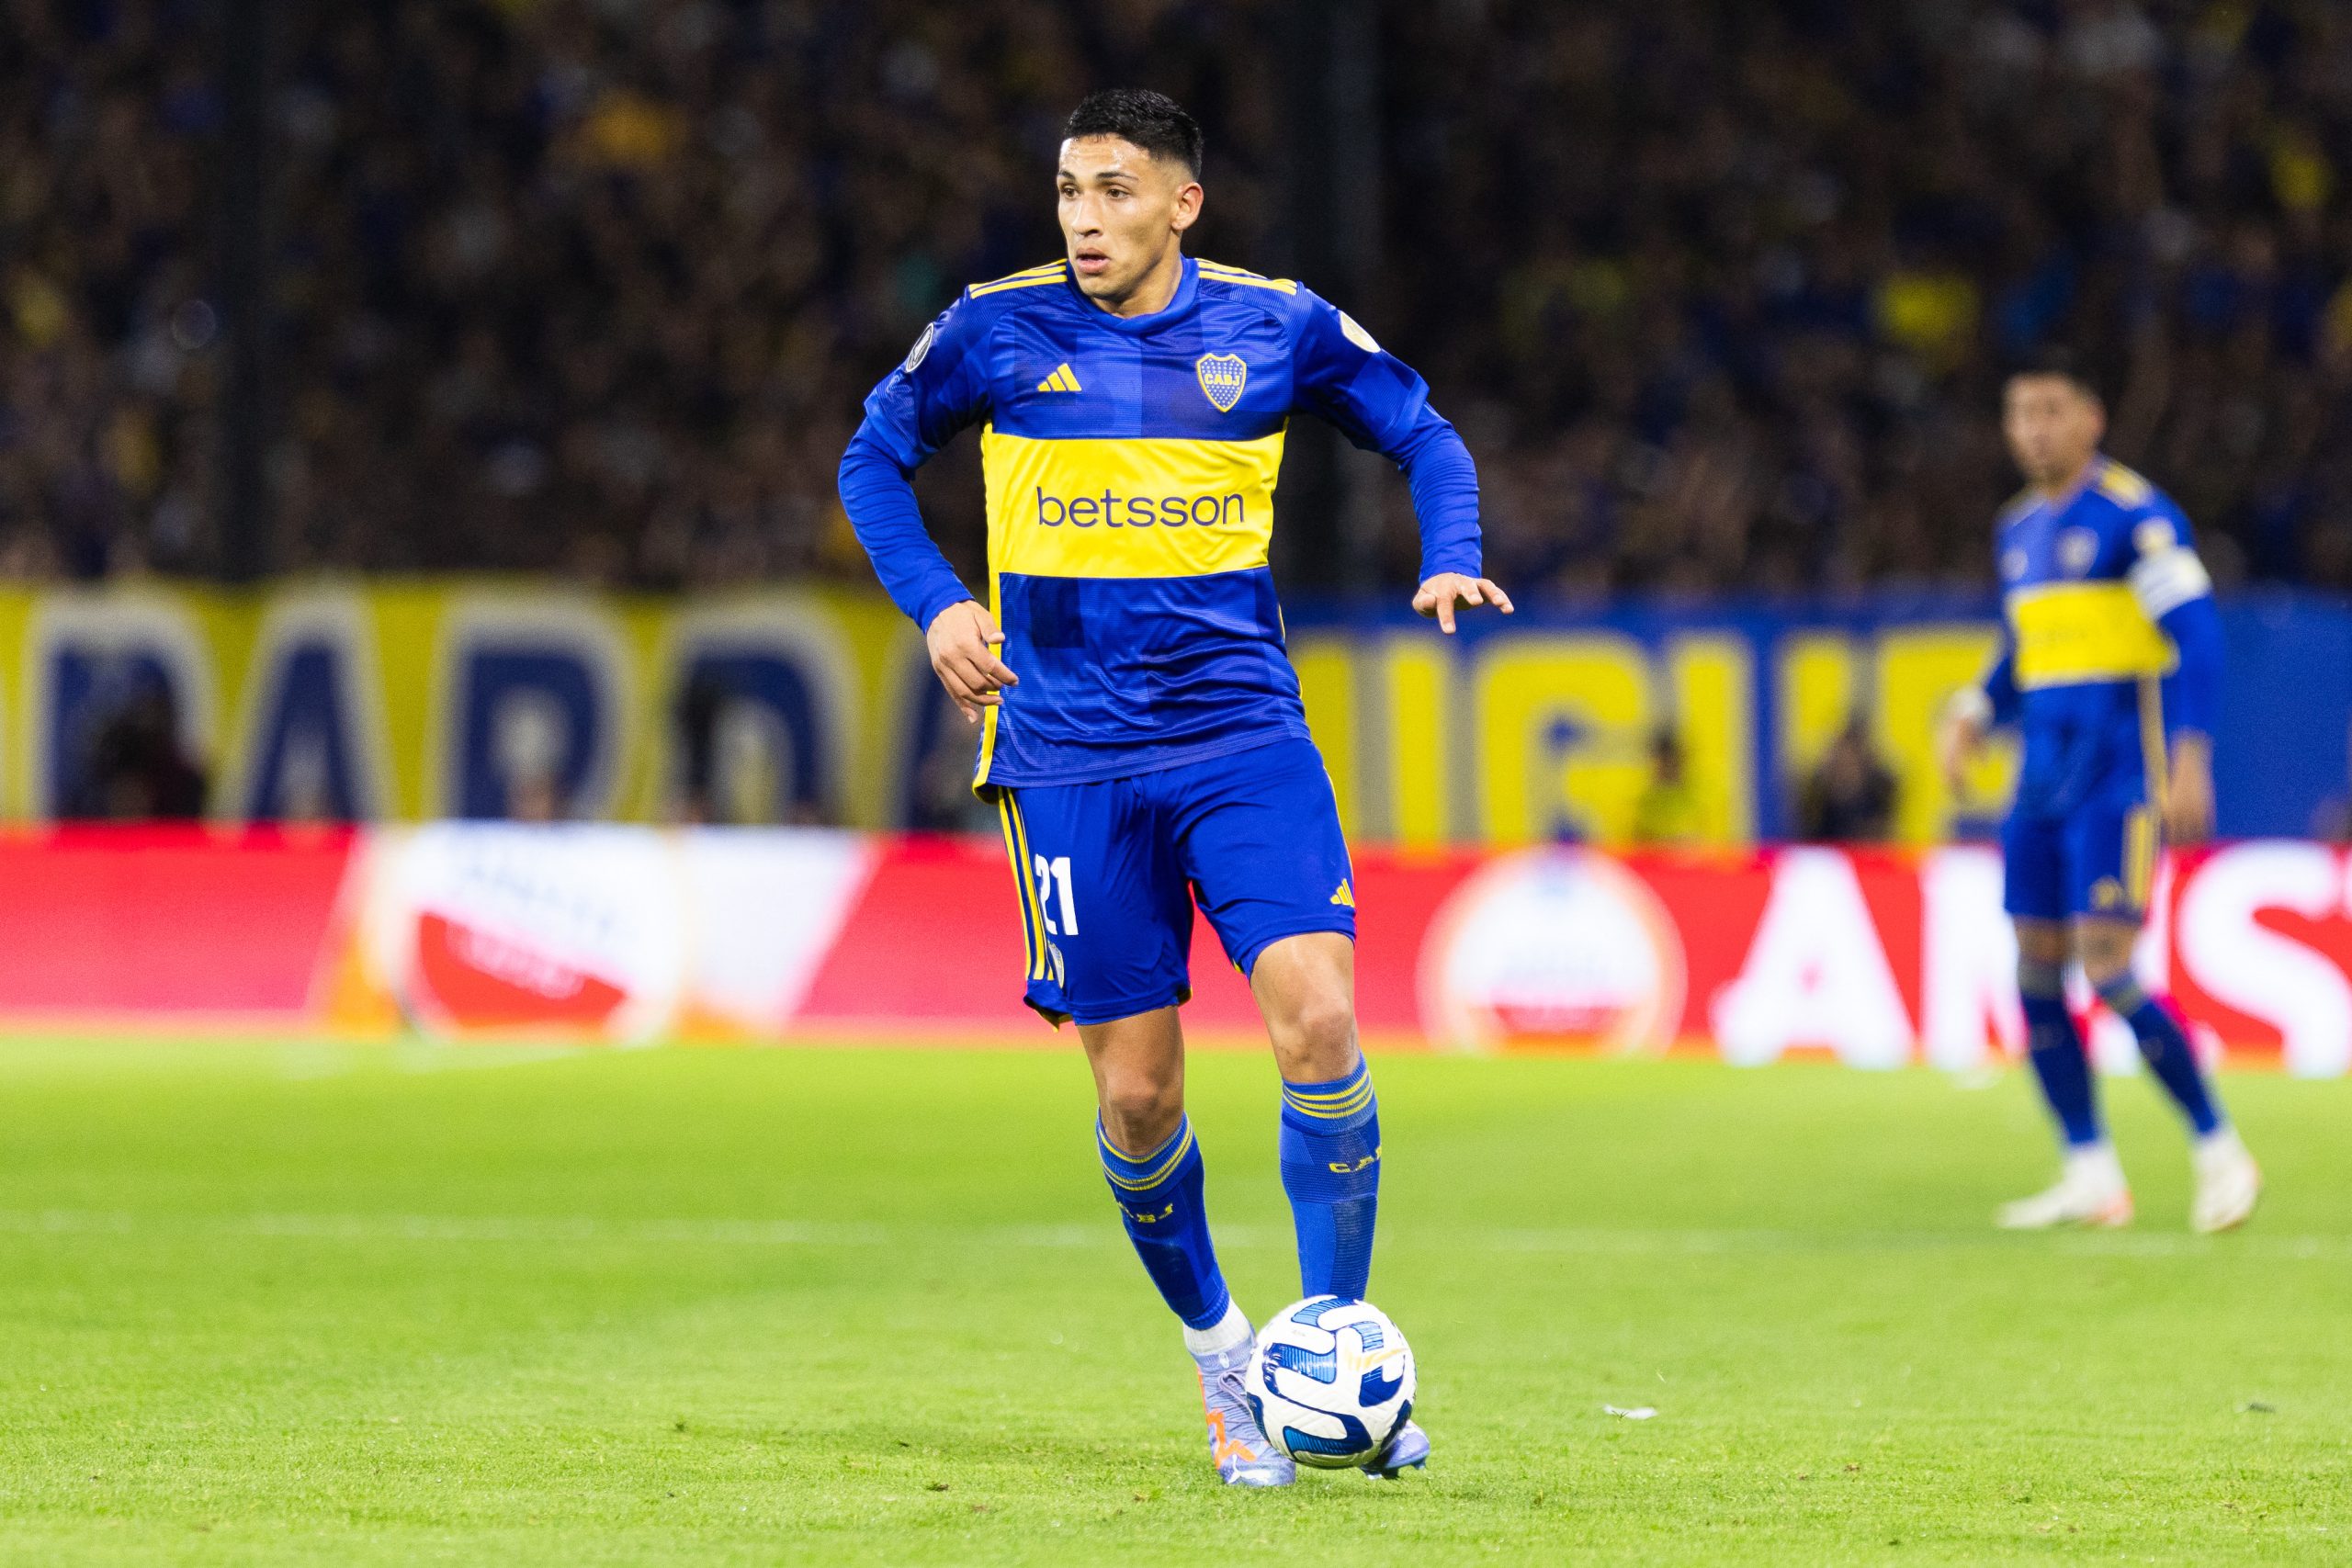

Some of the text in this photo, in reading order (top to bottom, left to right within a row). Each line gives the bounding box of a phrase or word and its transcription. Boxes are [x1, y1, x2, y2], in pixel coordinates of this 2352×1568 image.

[1204, 373, 1240, 386] CABJ
[1036, 486, 1245, 528] betsson
[1035, 853, 1080, 936] 21
